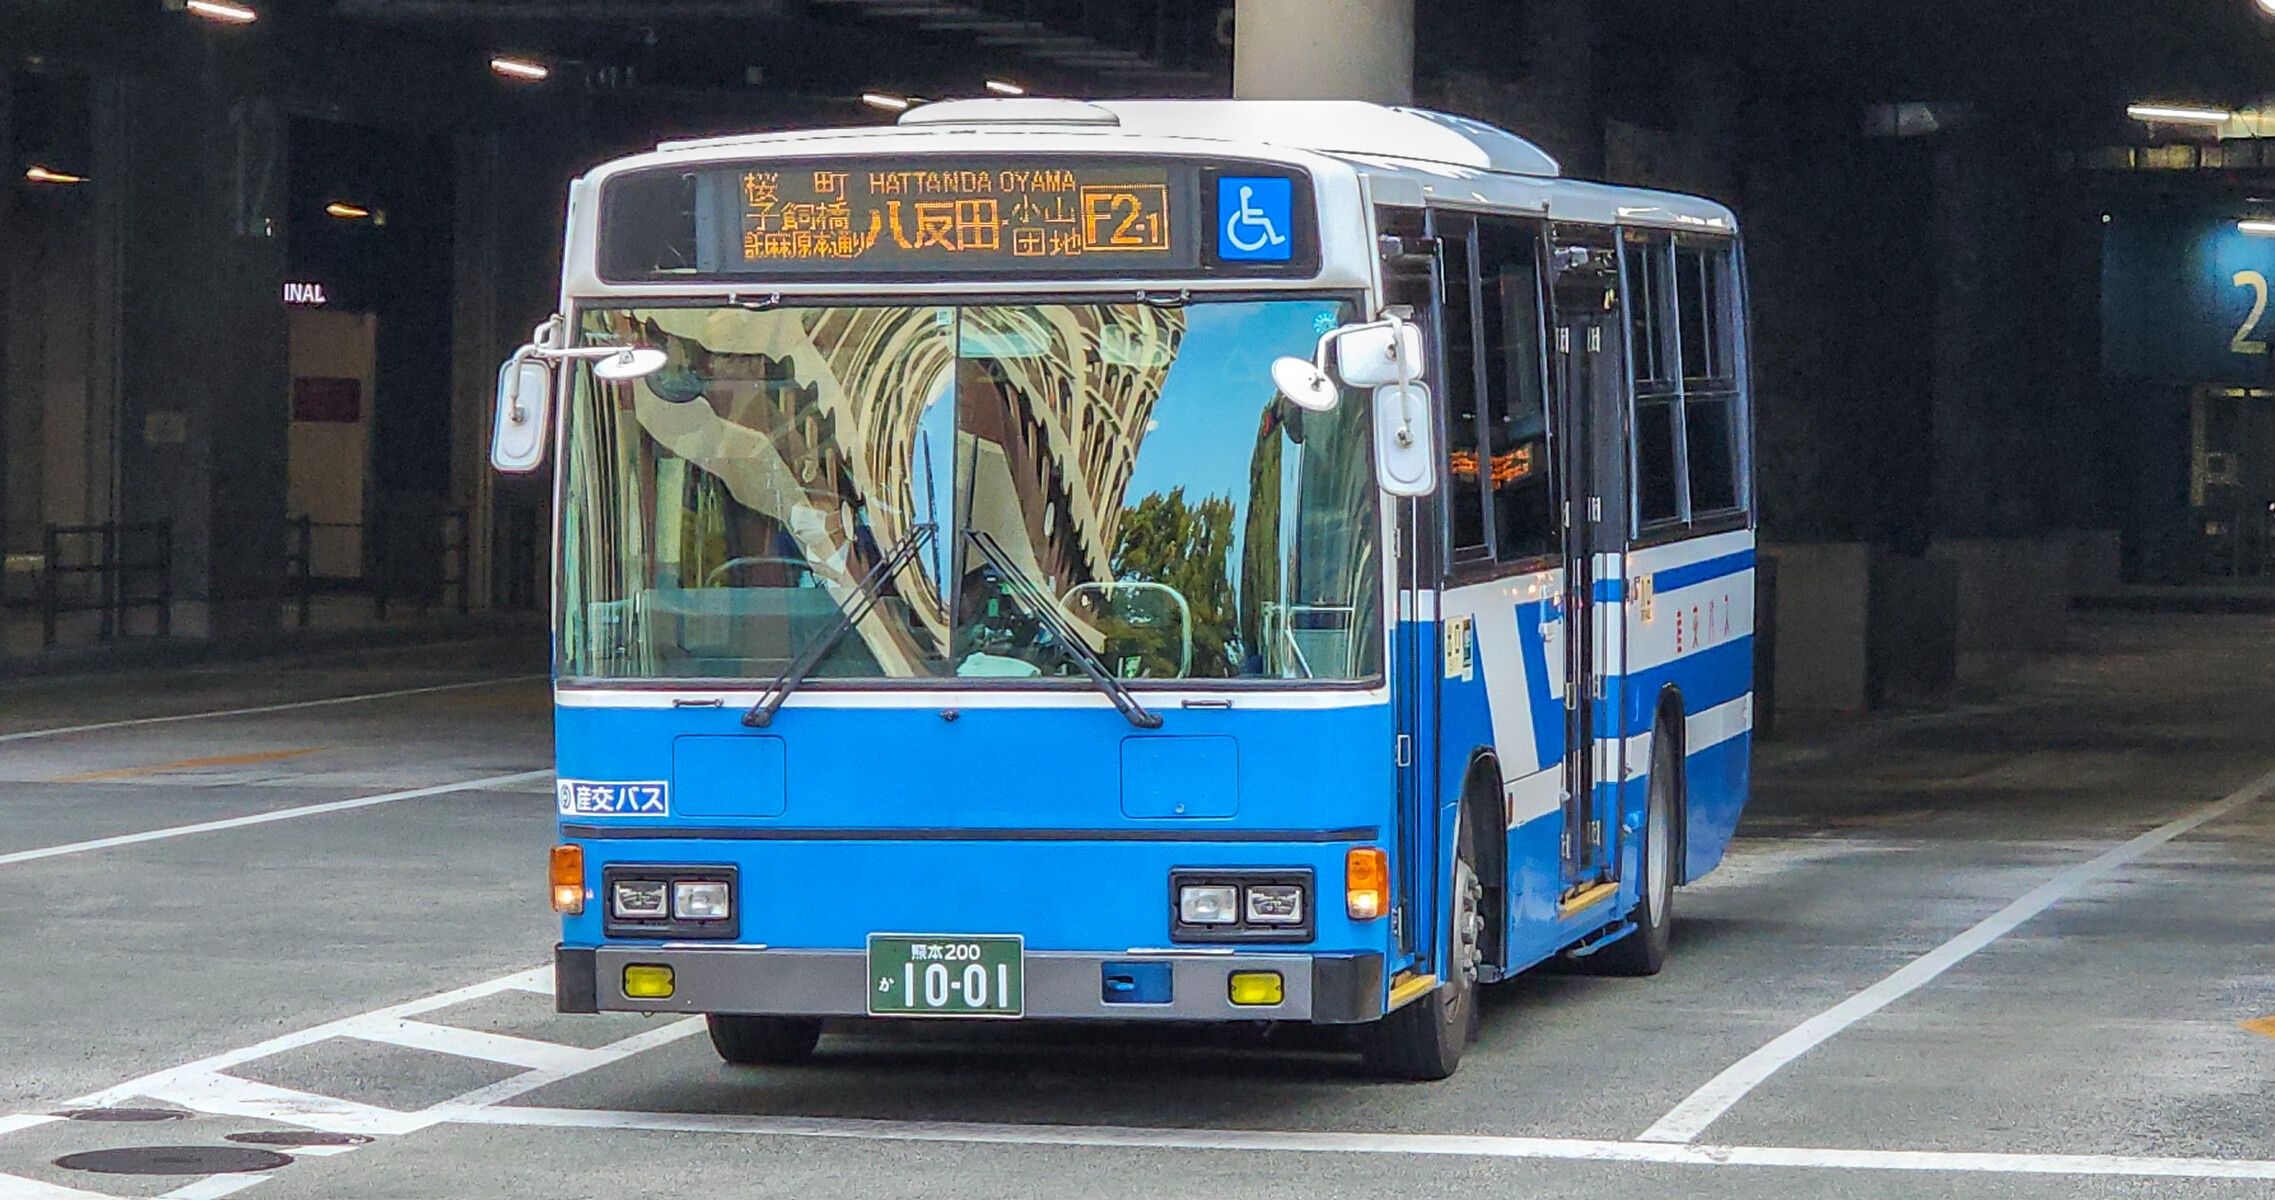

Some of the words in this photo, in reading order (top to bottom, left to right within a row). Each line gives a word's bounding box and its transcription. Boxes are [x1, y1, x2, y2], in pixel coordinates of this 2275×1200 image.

[868, 171, 993, 195] HATTANDA
[999, 169, 1077, 193] OYAMA
[745, 201, 851, 231] 子飼橋
[2231, 270, 2269, 355] 2
[575, 785, 665, 812] 産交バス
[904, 961, 1008, 1009] 10-01
